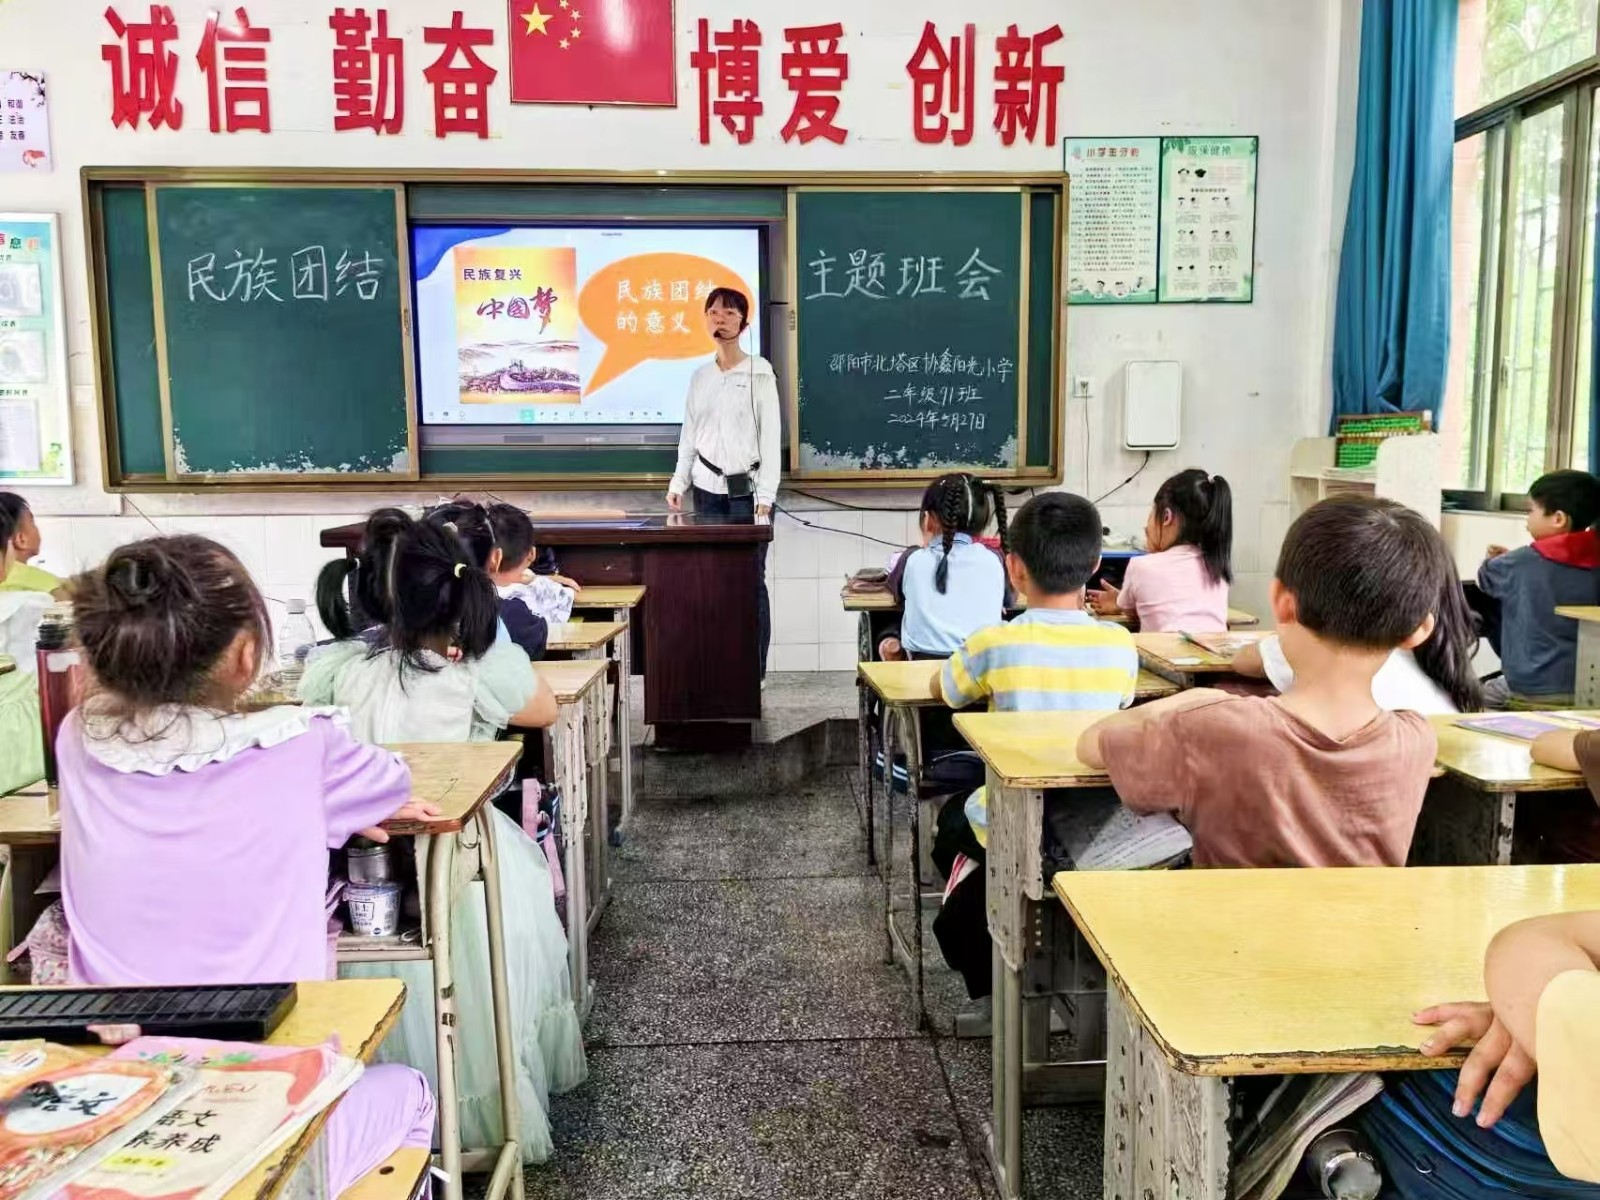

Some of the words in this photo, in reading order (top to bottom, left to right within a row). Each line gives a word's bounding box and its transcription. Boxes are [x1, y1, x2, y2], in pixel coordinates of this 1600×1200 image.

[101, 4, 272, 133] 诚信
[329, 7, 498, 139] 勤奋
[690, 18, 849, 145] 博爱
[906, 20, 1066, 147] 创新
[187, 245, 385, 302] 民族团结
[463, 268, 523, 281] 民族复兴
[804, 247, 1004, 301] 主题班会
[476, 286, 558, 335] 中国梦
[616, 312, 692, 334] 的意义
